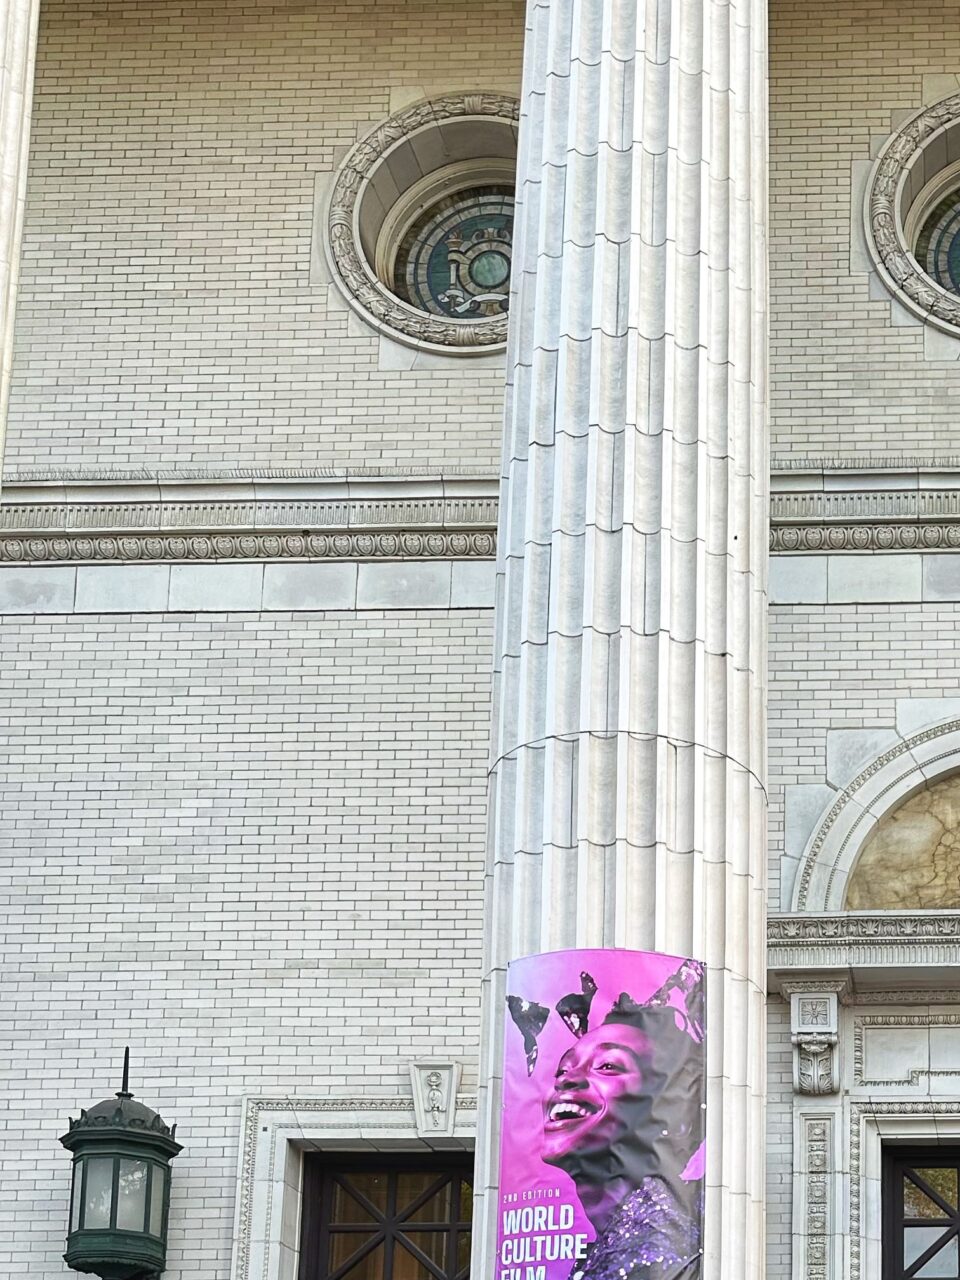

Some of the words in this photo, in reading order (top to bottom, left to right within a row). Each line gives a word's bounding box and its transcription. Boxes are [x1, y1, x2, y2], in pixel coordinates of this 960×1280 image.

[503, 1193, 518, 1204] 2ND
[522, 1188, 560, 1201] EDITION
[503, 1204, 574, 1235] WORLD
[501, 1233, 588, 1265] CULTURE
